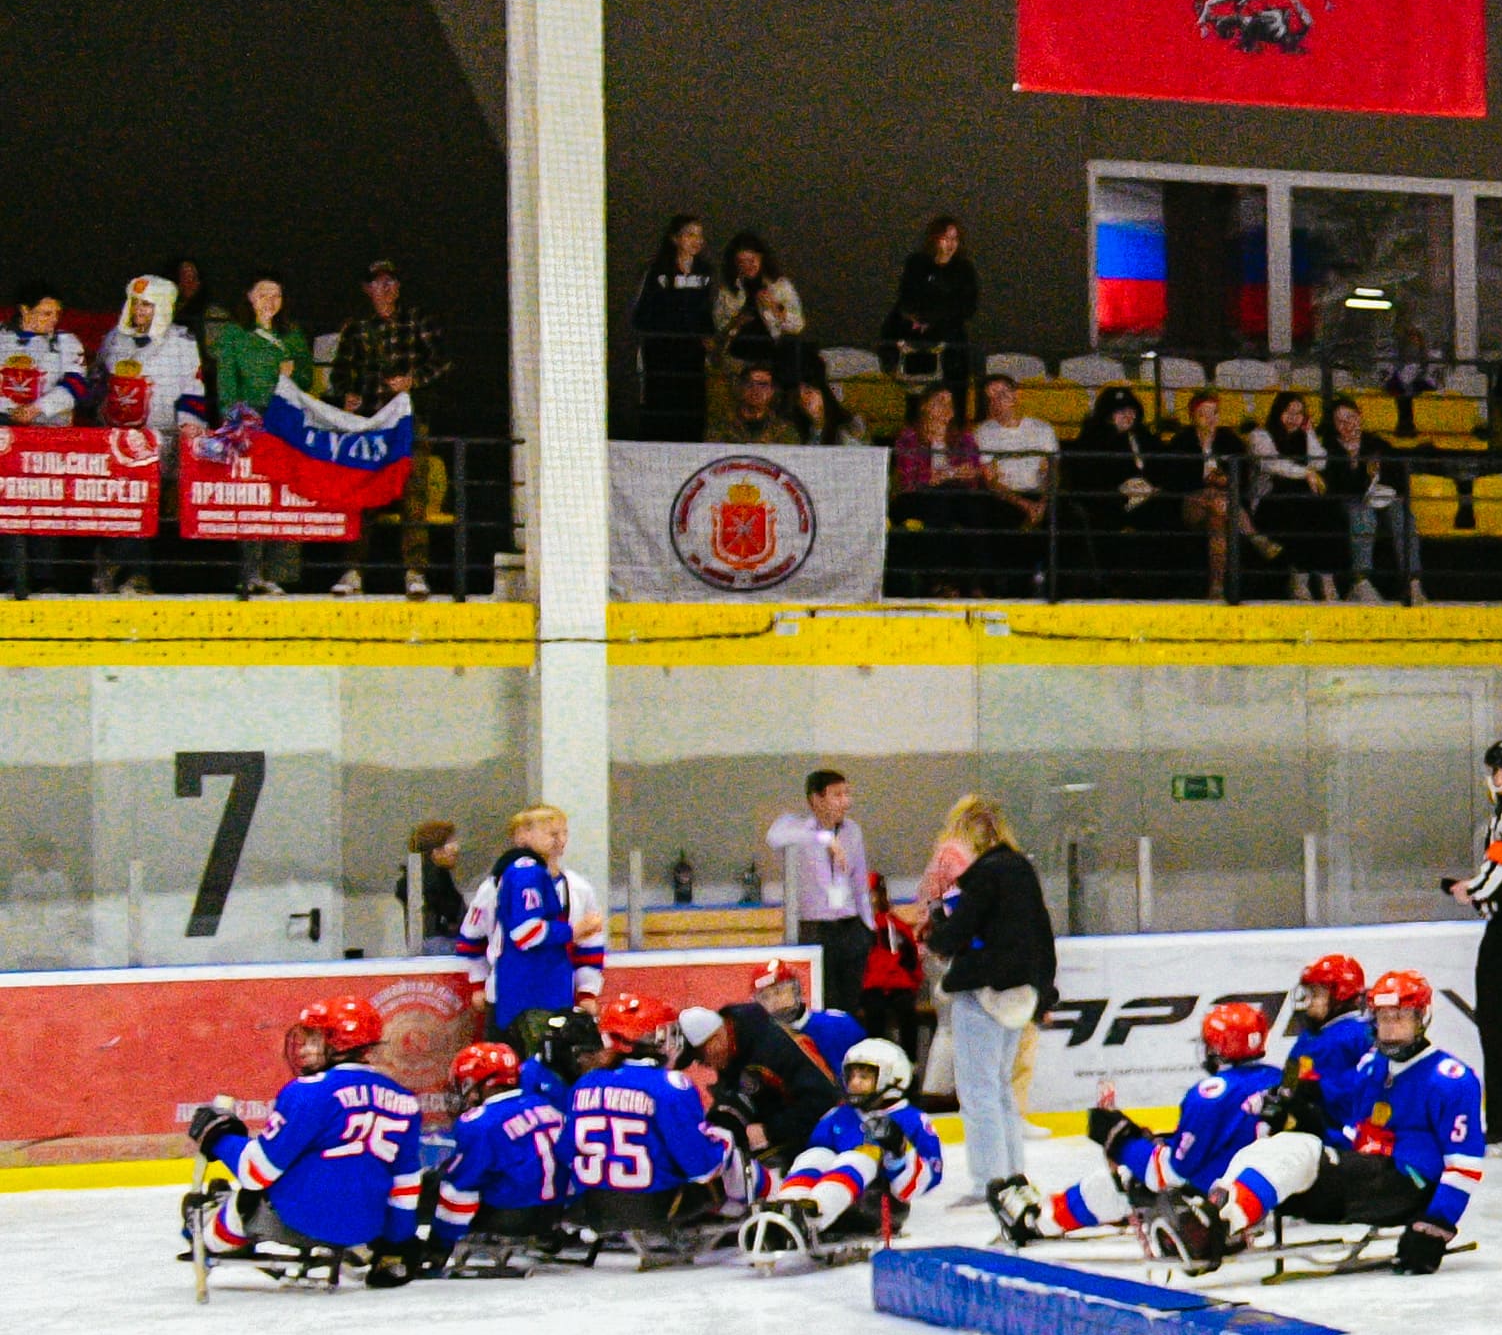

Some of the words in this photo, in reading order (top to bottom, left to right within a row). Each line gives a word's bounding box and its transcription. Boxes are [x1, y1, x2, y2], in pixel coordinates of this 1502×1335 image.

[174, 751, 266, 938] 7
[321, 1111, 412, 1165] 25
[573, 1115, 654, 1189] 55
